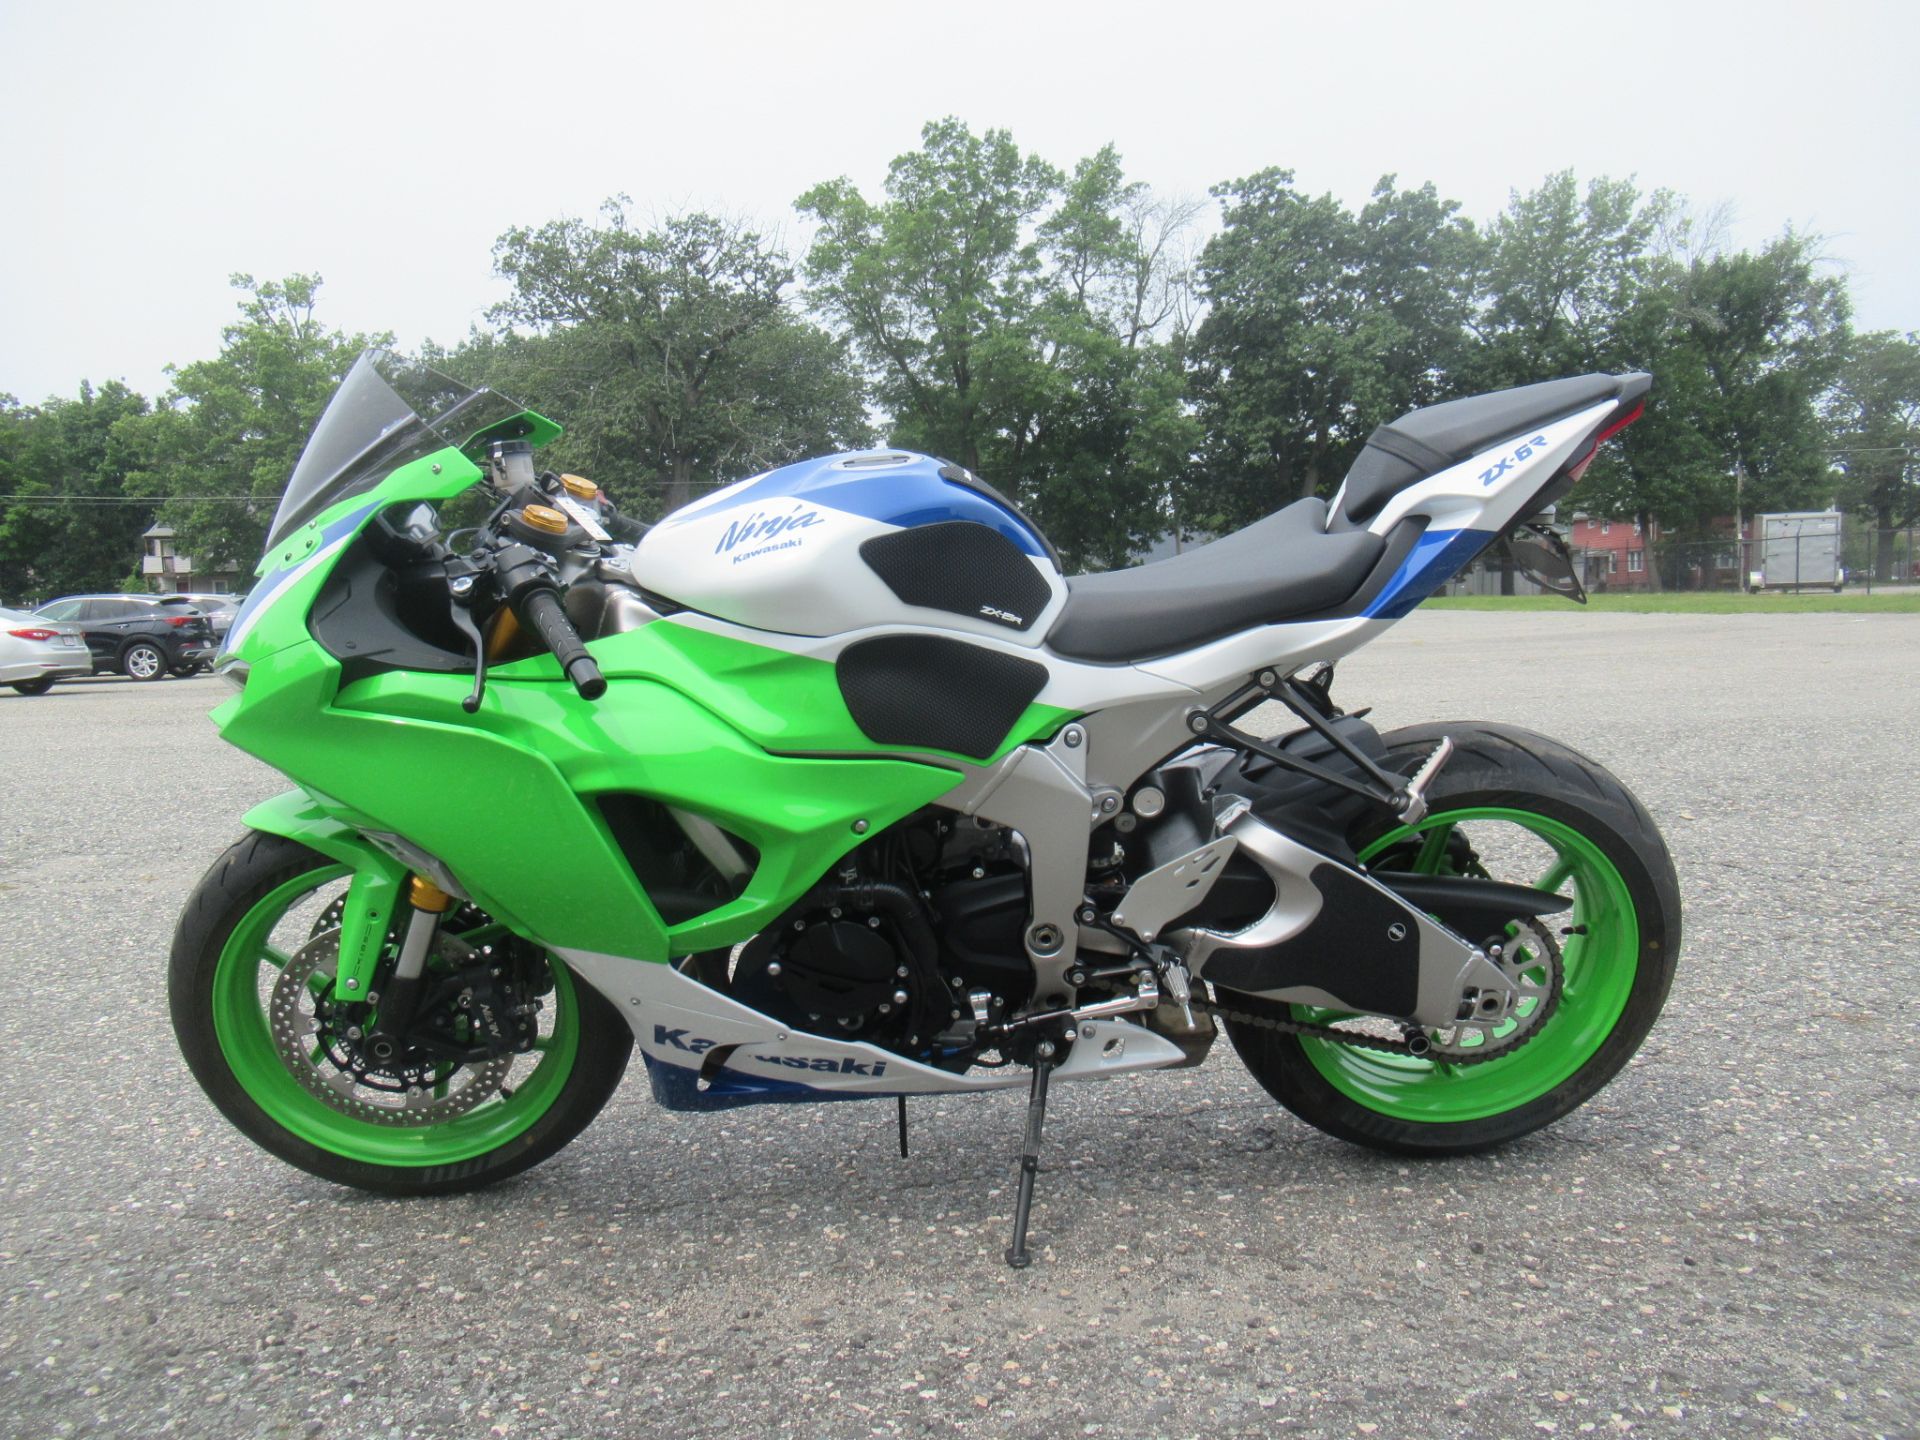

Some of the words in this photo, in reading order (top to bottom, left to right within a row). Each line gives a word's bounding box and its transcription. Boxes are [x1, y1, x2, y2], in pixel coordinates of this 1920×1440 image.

[1478, 435, 1547, 487] ZX-6R
[715, 504, 825, 554] Ninja
[733, 537, 802, 565] Kawasaki
[654, 1024, 887, 1076] Kaasaki
